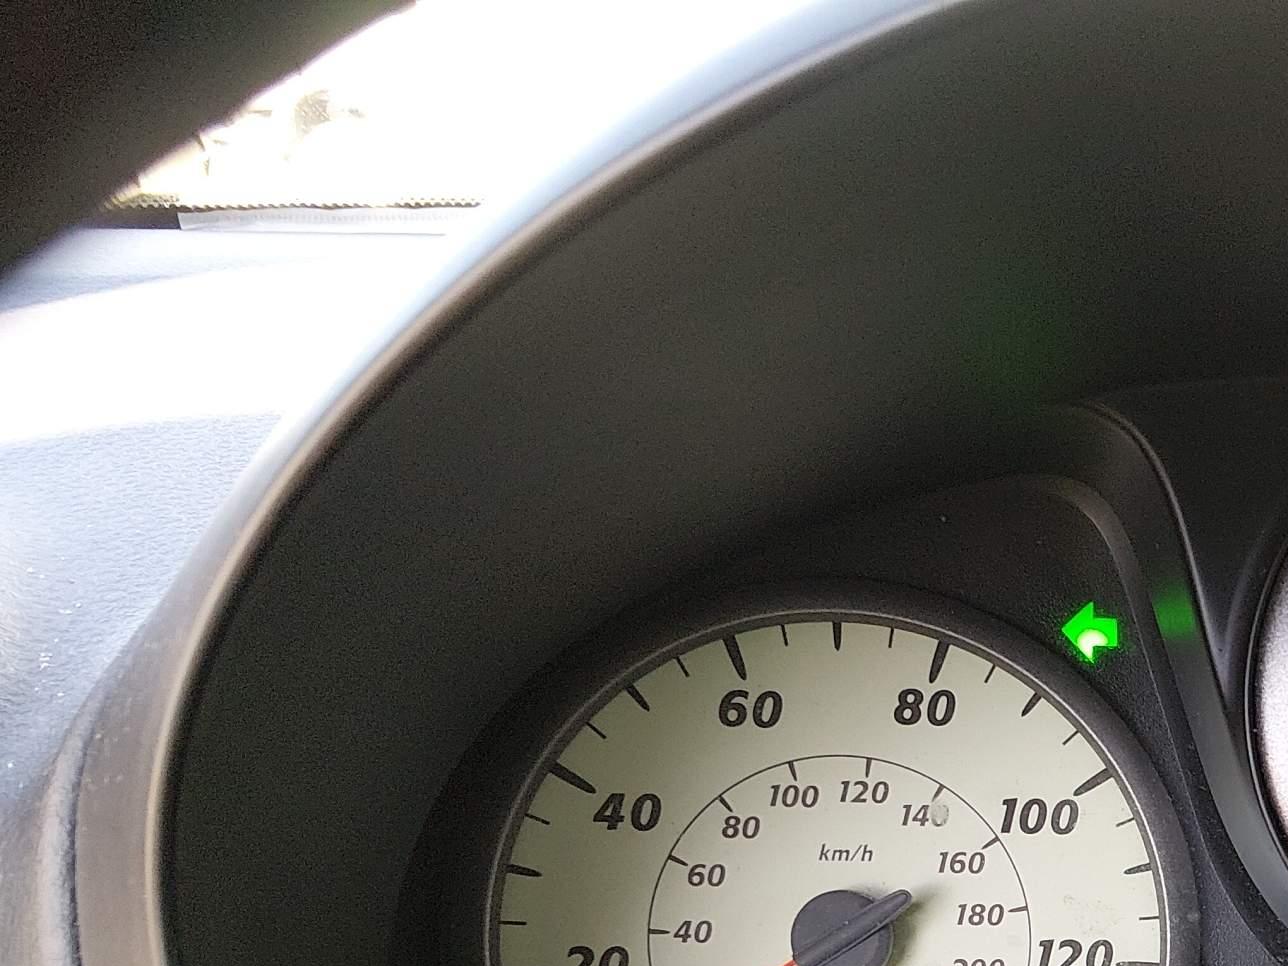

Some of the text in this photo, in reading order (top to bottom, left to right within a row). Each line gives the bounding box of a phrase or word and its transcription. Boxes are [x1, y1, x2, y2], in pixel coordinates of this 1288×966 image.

[718, 689, 783, 728] 60
[893, 688, 956, 727] 80
[769, 784, 820, 809] 100
[840, 780, 889, 804] 120
[592, 792, 662, 831] 40
[901, 804, 950, 827] 140
[1000, 798, 1080, 835] 100
[721, 815, 761, 839] 80
[819, 843, 873, 862] km/h
[938, 851, 986, 875] 160
[687, 863, 726, 887] 60
[956, 903, 1005, 926] 180
[673, 920, 713, 943] 40
